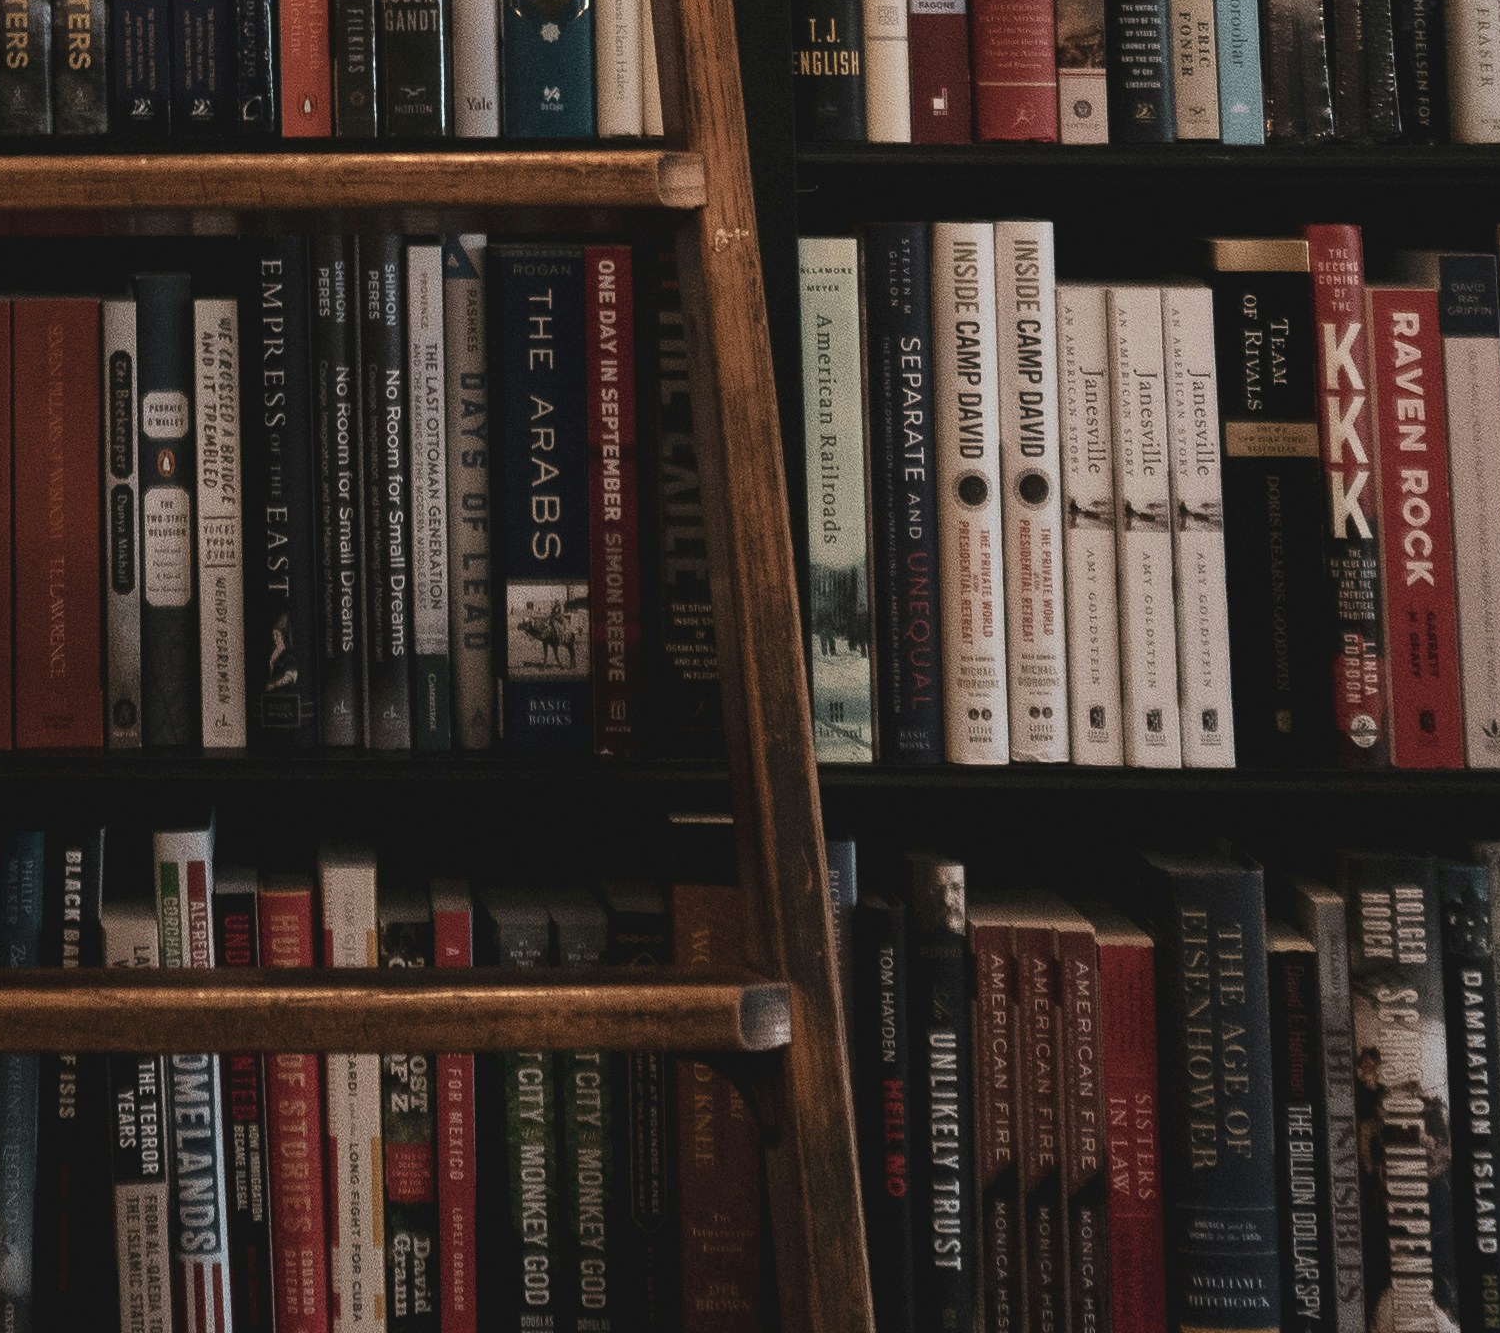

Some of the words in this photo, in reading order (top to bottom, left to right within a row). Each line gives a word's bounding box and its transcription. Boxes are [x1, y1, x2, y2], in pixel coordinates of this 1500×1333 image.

[952, 240, 978, 315] INSIDE
[526, 287, 554, 373] THE
[954, 321, 983, 385] CAMP
[956, 391, 985, 460] DAVID
[1390, 311, 1428, 453] RAVEN
[528, 394, 561, 561] ARABS
[1399, 466, 1436, 588] ROCK
[927, 1031, 962, 1174] UNLIKELY
[931, 1180, 964, 1273] TRUST
